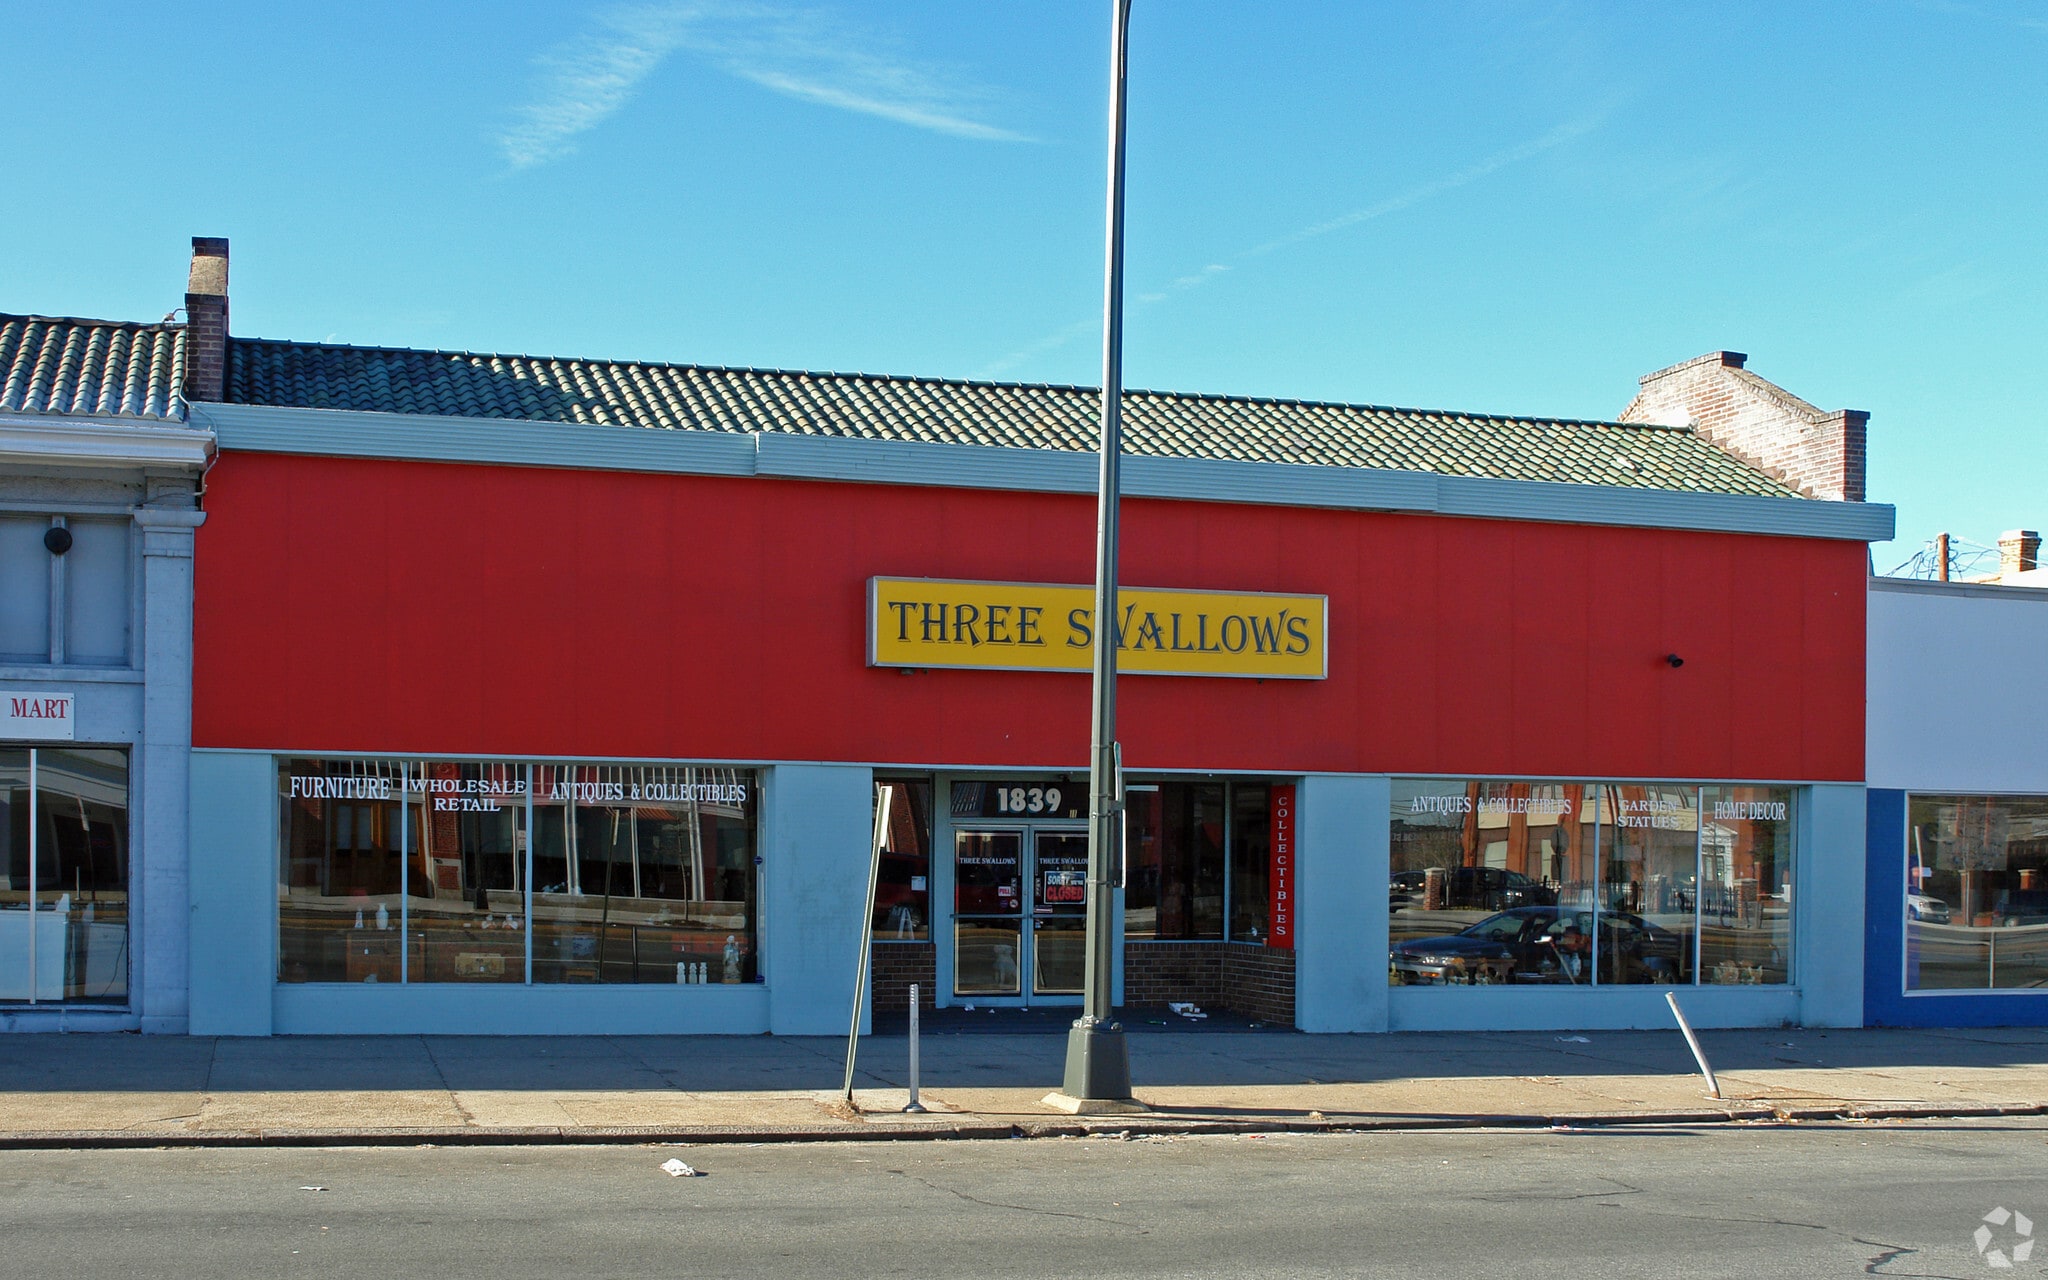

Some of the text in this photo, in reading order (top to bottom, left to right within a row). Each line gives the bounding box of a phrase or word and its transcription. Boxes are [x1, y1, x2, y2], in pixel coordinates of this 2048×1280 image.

[888, 601, 1047, 648] THREE
[10, 697, 69, 719] MART
[290, 776, 391, 800] FURNITURE
[409, 778, 527, 795] WHOLESALE
[550, 782, 747, 803] ANTIQUES & COLLECTIBLES
[433, 798, 501, 812] RETAIL
[997, 788, 1062, 812] 1839
[1411, 796, 1572, 816] ANTIQUES & COLLECTIBLES
[1619, 800, 1677, 812] GARDEN
[1714, 801, 1786, 821] HOME DECOR
[1617, 815, 1679, 828] STATUES
[959, 856, 1016, 865] THREE SWALLOWS
[1039, 857, 1089, 865] THREE SWALLO
[1276, 797, 1288, 936] COLLECTIBLES
[1047, 875, 1071, 885] SORRY
[1047, 886, 1083, 901] CLOSED
